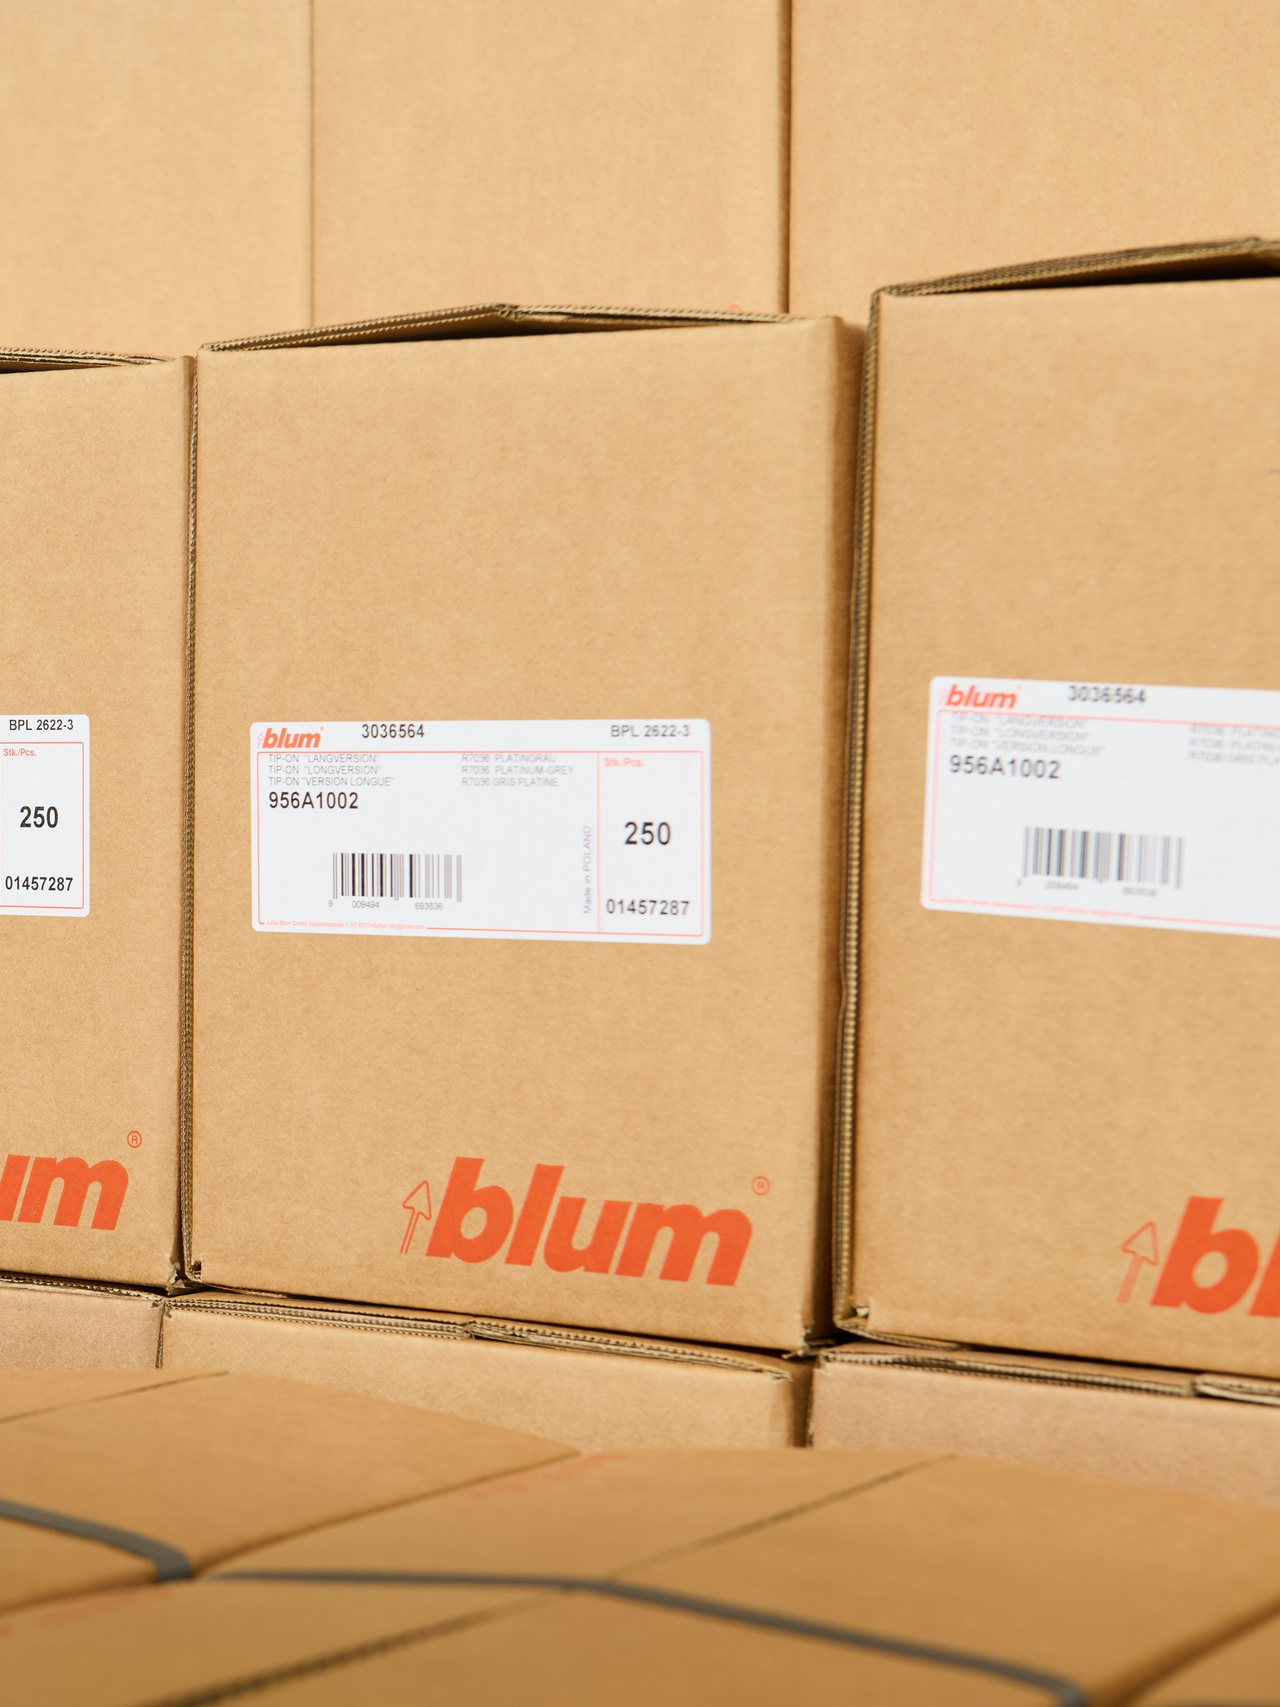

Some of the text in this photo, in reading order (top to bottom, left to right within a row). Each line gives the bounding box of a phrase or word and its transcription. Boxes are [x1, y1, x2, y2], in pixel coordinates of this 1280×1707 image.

[946, 684, 1017, 709] blum
[1068, 686, 1146, 703] 3036564
[9, 719, 74, 731] BPL 2622-3
[362, 724, 425, 738] 3036564
[611, 725, 690, 737] BPL 2622-3
[262, 728, 321, 748] blum
[3, 748, 37, 757] Stk./Pcs.
[268, 754, 300, 763] TIP-ON
[461, 754, 557, 763] R7036 PLATINGRAU
[268, 766, 300, 774] TIP-ON
[461, 766, 574, 775] R7036 PLATINUM-GREY
[949, 755, 1061, 779] 956A1002
[268, 777, 300, 786] TIP-ON
[461, 778, 559, 787] R7036 GRIS PLATINE
[269, 791, 359, 809] 956A1002
[20, 806, 58, 828] 250
[625, 821, 671, 845] 250
[583, 825, 591, 872] POLAND
[5, 876, 73, 891] 01457287
[352, 900, 379, 909] 009494
[415, 902, 443, 910] 693836
[583, 887, 591, 914] Made
[606, 899, 690, 915] 01457287
[426, 1157, 752, 1286] blum
